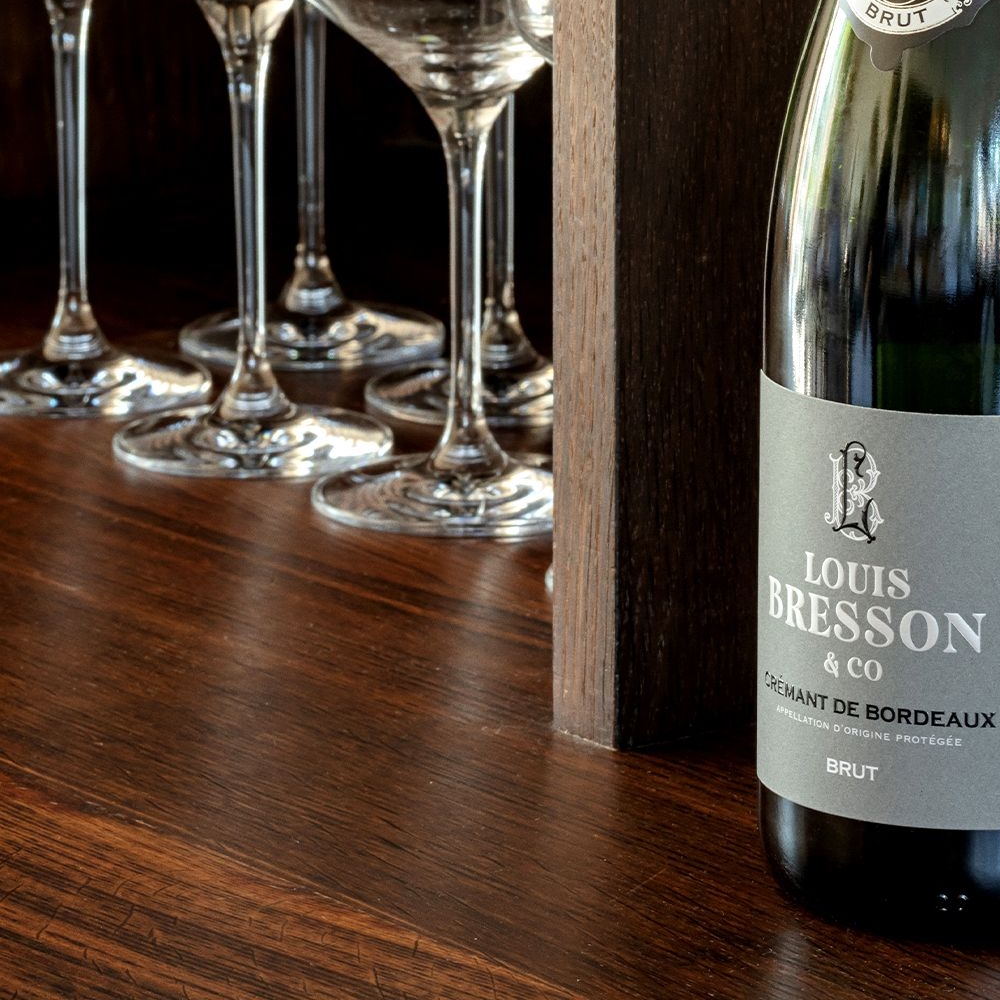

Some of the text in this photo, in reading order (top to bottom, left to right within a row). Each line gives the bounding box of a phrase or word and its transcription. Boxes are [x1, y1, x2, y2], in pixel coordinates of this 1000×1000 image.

[864, 3, 928, 27] BRUT
[804, 551, 911, 600] LOUIS
[768, 574, 987, 654] BRESSON
[822, 651, 884, 682] & CO
[764, 670, 997, 729] CRÉMANT DE BORDEAUX
[776, 704, 963, 747] APPELLATION D'ORIGINE PROTÉGÉE
[826, 757, 879, 782] BRUT
